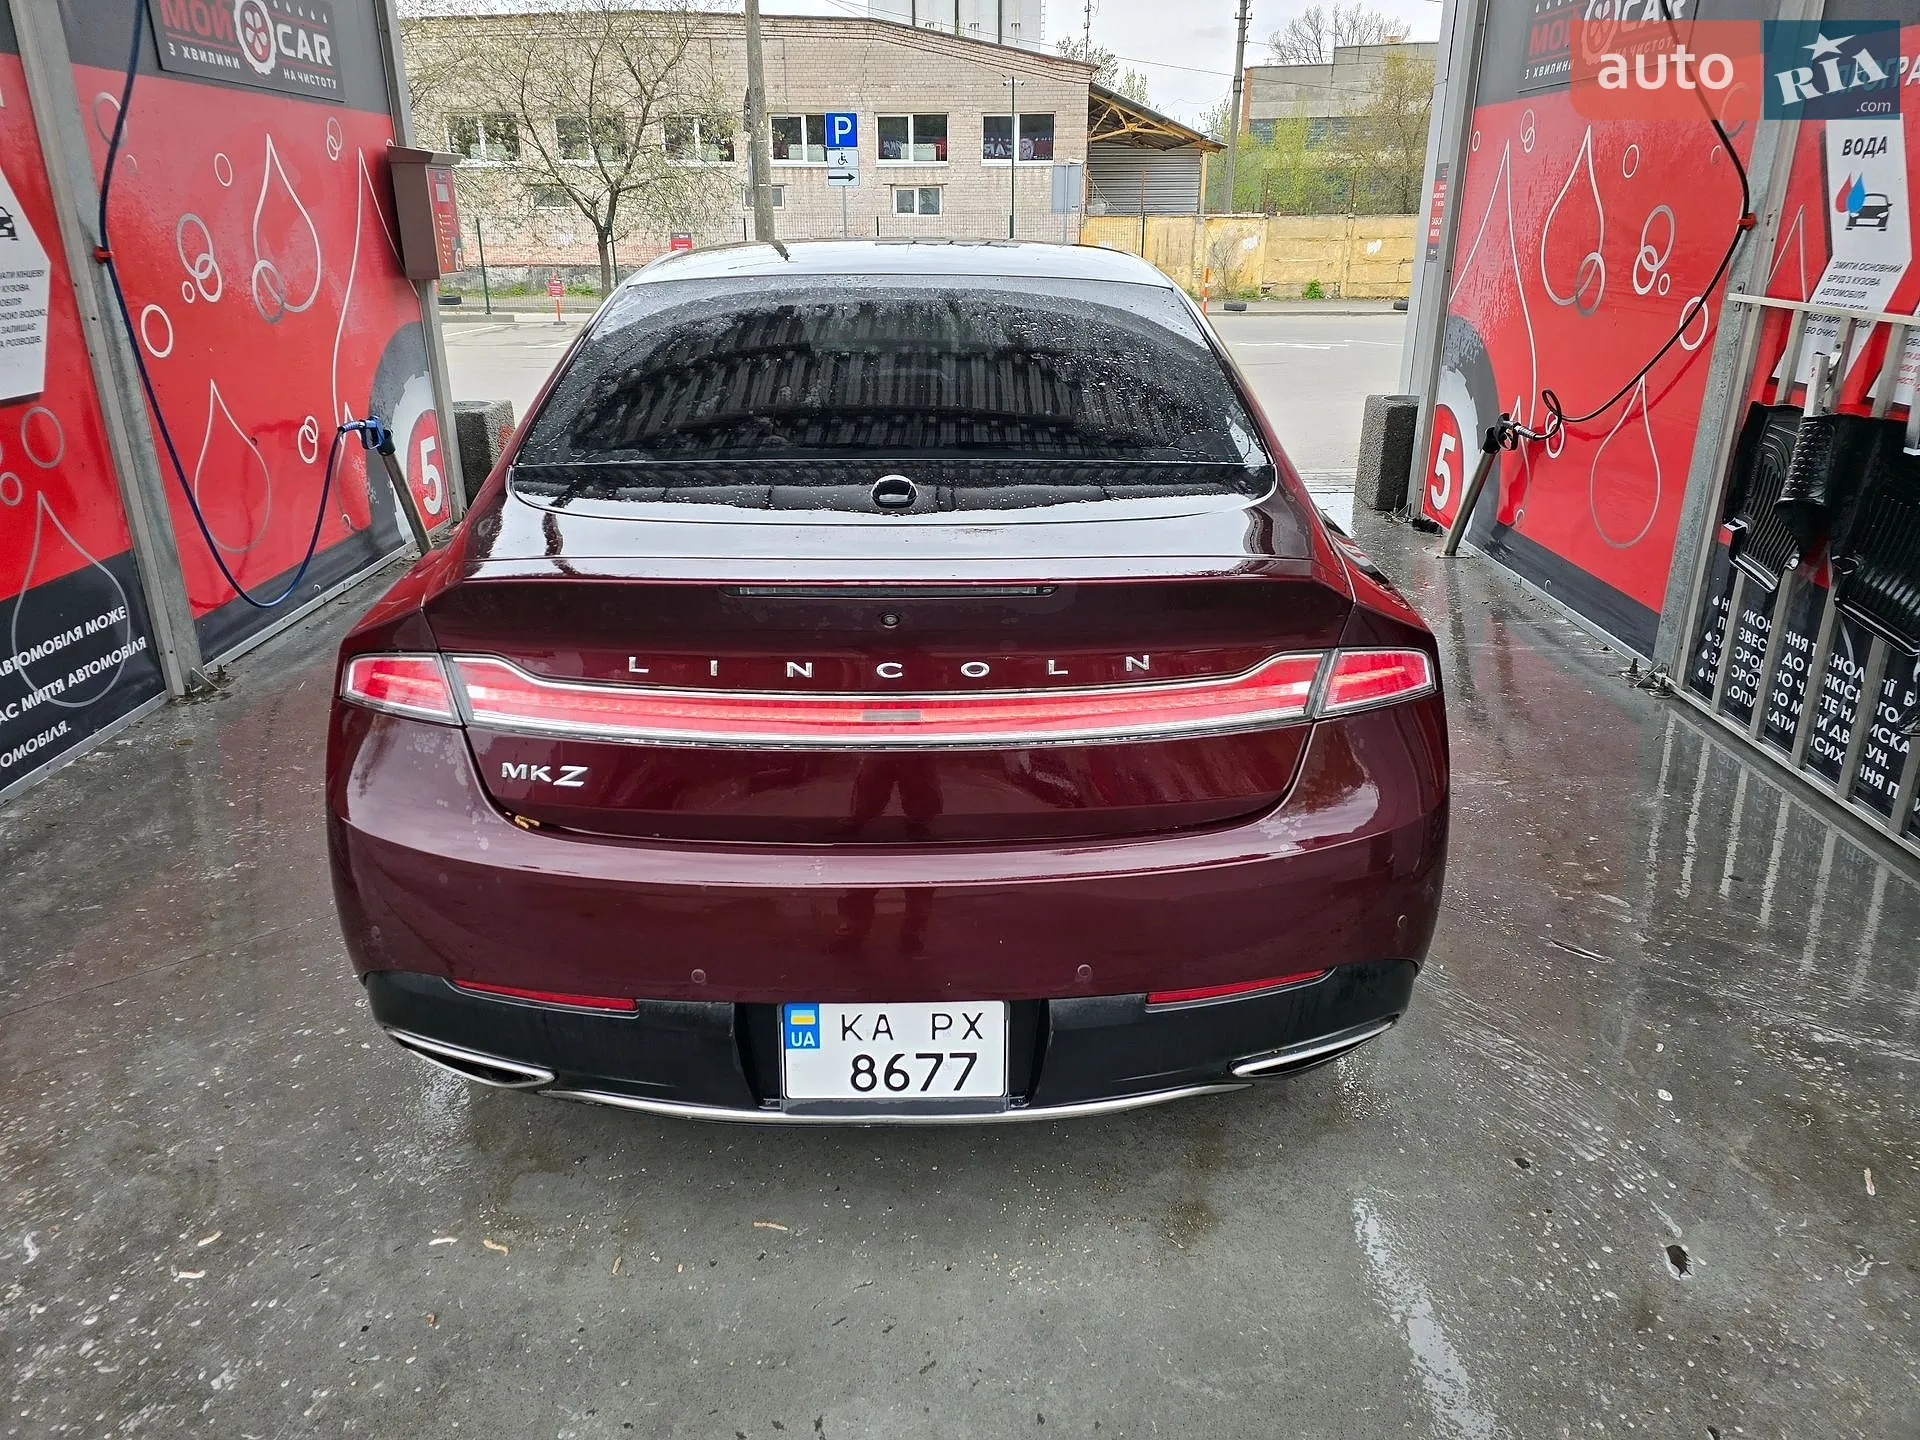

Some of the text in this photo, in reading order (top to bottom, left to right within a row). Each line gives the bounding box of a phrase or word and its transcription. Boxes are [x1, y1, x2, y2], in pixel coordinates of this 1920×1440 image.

[277, 23, 333, 67] CAR
[180, 44, 241, 70] ХВИЛИНИ
[283, 67, 297, 81] НА
[297, 71, 337, 90] ЧИСТОТУ
[834, 116, 852, 145] P
[1841, 136, 1888, 159] ВОДА
[1819, 287, 1868, 300] АВТОМОБІЛЯ
[420, 436, 442, 515] 5
[1431, 432, 1456, 510] 5
[85, 605, 127, 636] МОЖЕ
[21, 678, 66, 712] МИТТЯ
[68, 636, 147, 687] АВТОМОБІЛЯ
[628, 654, 1150, 679] LINCOLN
[1781, 651, 1805, 672] ДО
[501, 762, 589, 787] MKZ
[790, 1031, 816, 1048] UA
[850, 1052, 978, 1093] 8677
